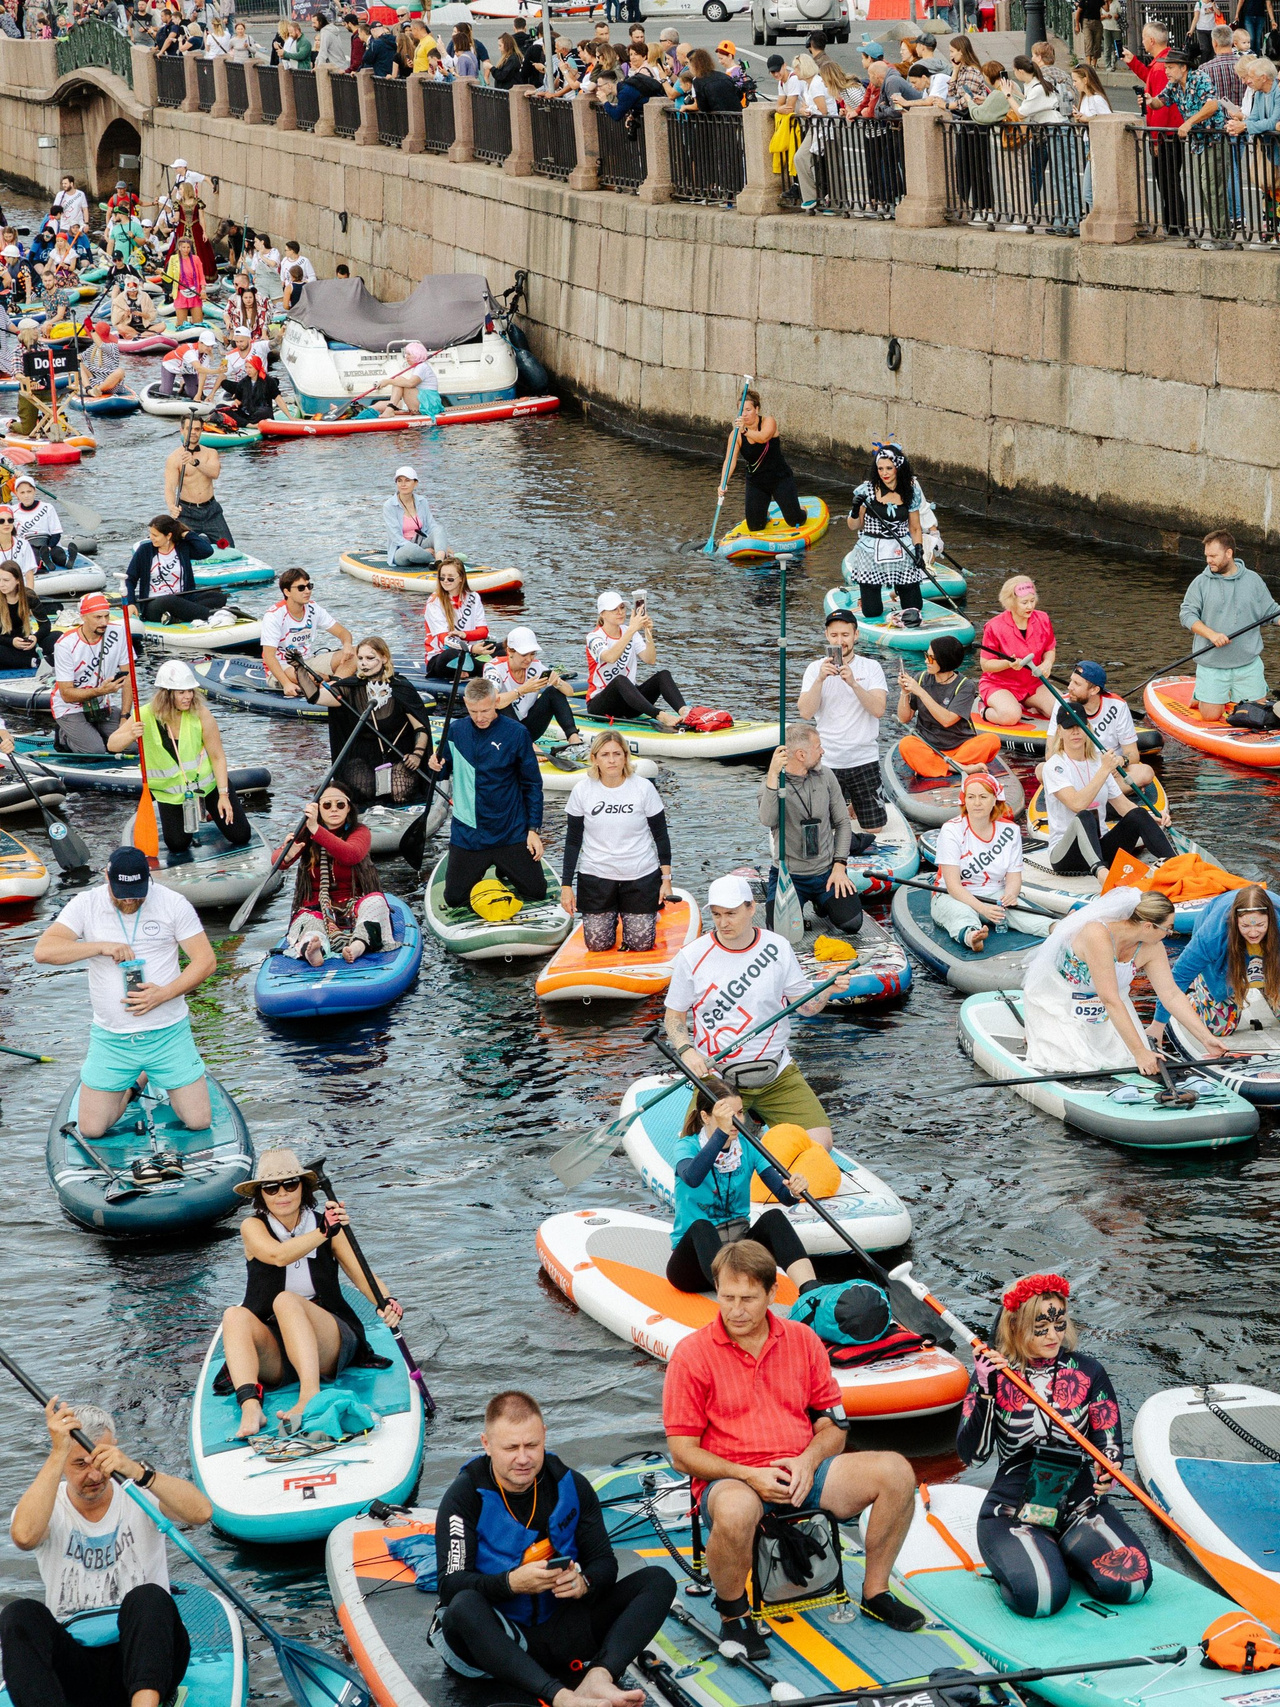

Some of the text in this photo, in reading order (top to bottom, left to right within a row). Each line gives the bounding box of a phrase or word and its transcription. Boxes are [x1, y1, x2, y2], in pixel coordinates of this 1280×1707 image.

[604, 803, 634, 814] asics
[959, 825, 1015, 882] etlGroup
[700, 940, 780, 1031] SetlGroup
